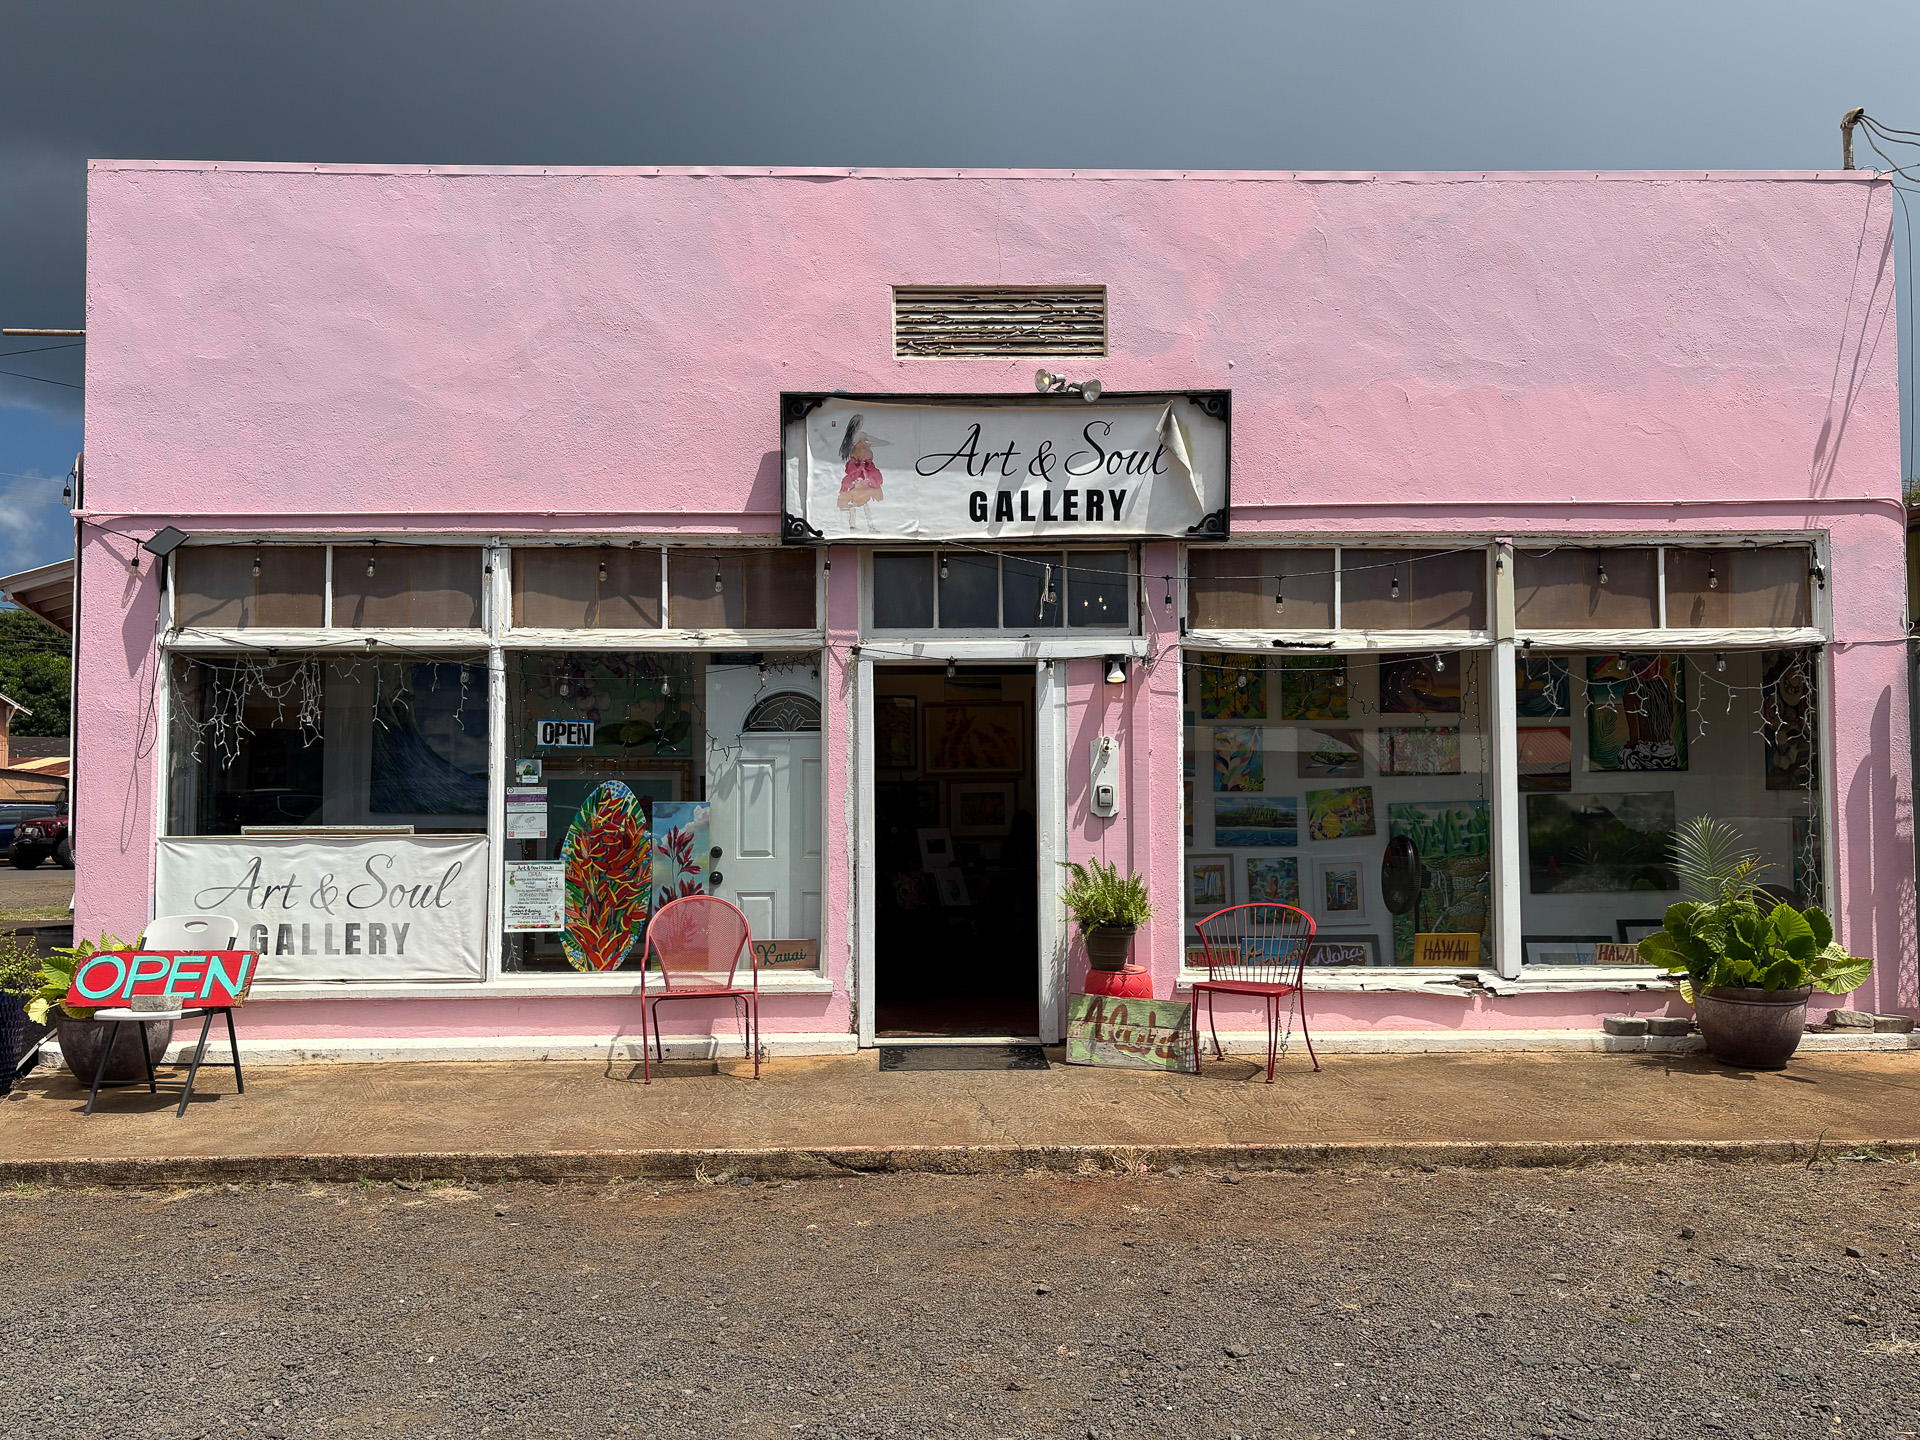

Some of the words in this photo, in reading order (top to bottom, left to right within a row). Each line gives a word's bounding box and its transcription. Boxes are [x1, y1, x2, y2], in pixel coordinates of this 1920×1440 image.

[915, 422, 1022, 477] Art
[1028, 440, 1057, 483] &
[1064, 420, 1169, 477] Soul
[969, 489, 1127, 523] GALLERY
[542, 722, 591, 746] OPEN
[193, 856, 303, 910] Art
[309, 873, 339, 916] &
[346, 853, 463, 909] Soul
[249, 922, 411, 956] GALLERY
[756, 942, 807, 966] Kauai
[1310, 945, 1364, 965] Aloha
[1423, 938, 1469, 961] HAWAII
[75, 954, 254, 1001] OPEN
